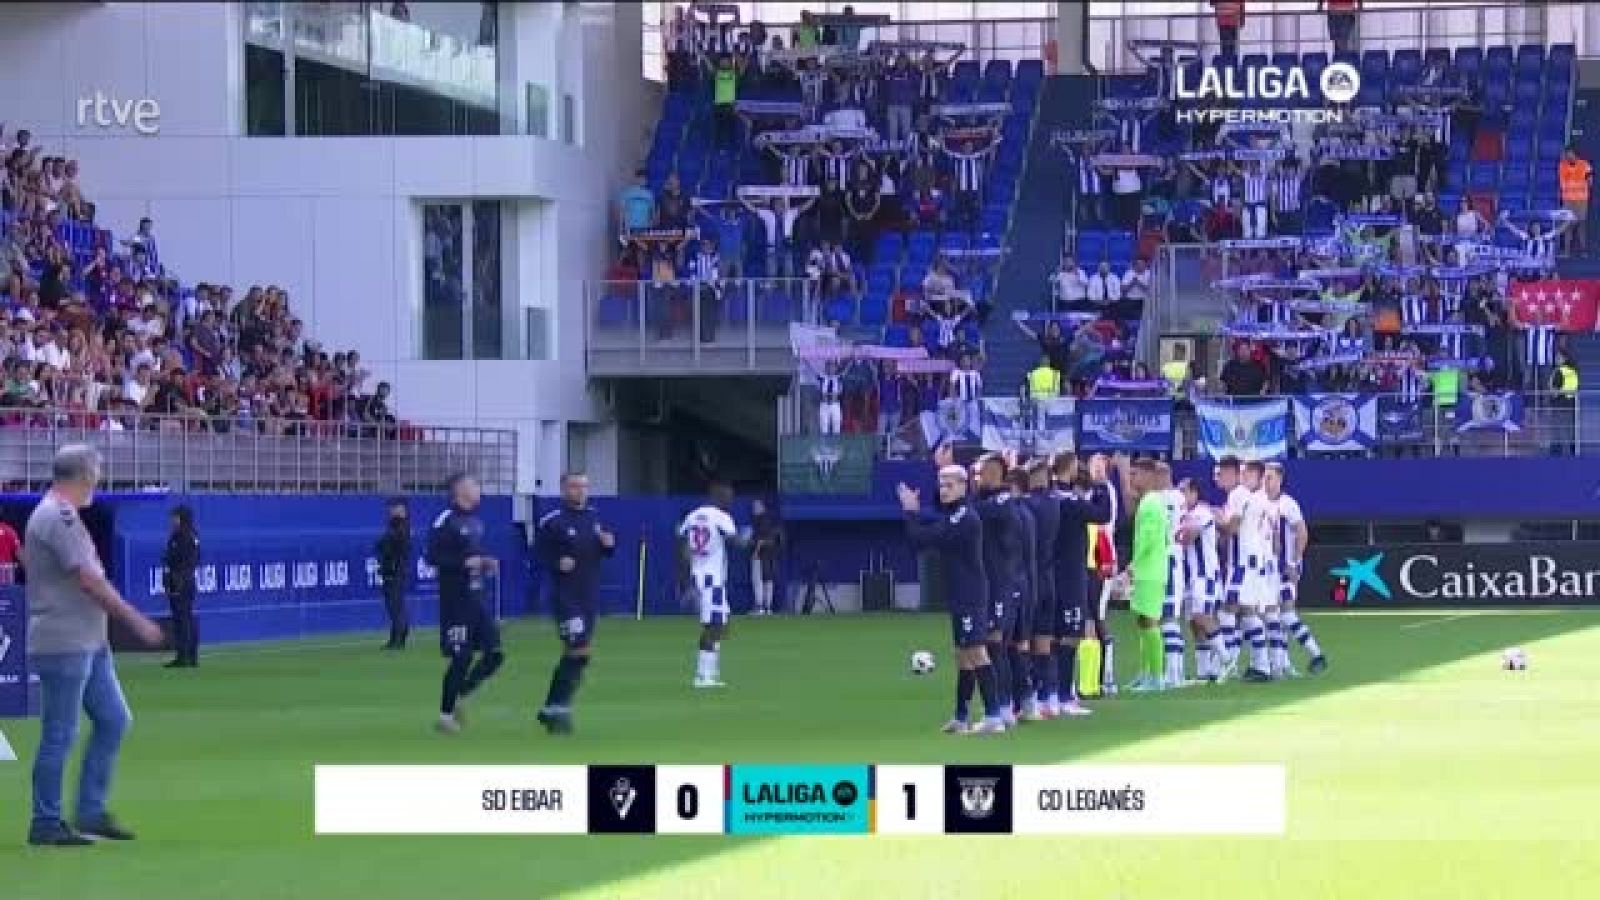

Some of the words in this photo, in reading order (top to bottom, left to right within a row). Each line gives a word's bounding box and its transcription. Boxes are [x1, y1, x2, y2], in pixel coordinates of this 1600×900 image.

[224, 563, 251, 591] LALIGA
[259, 562, 286, 590] LALIGA
[292, 561, 318, 588] LALIGA
[324, 560, 349, 586] LALIGA
